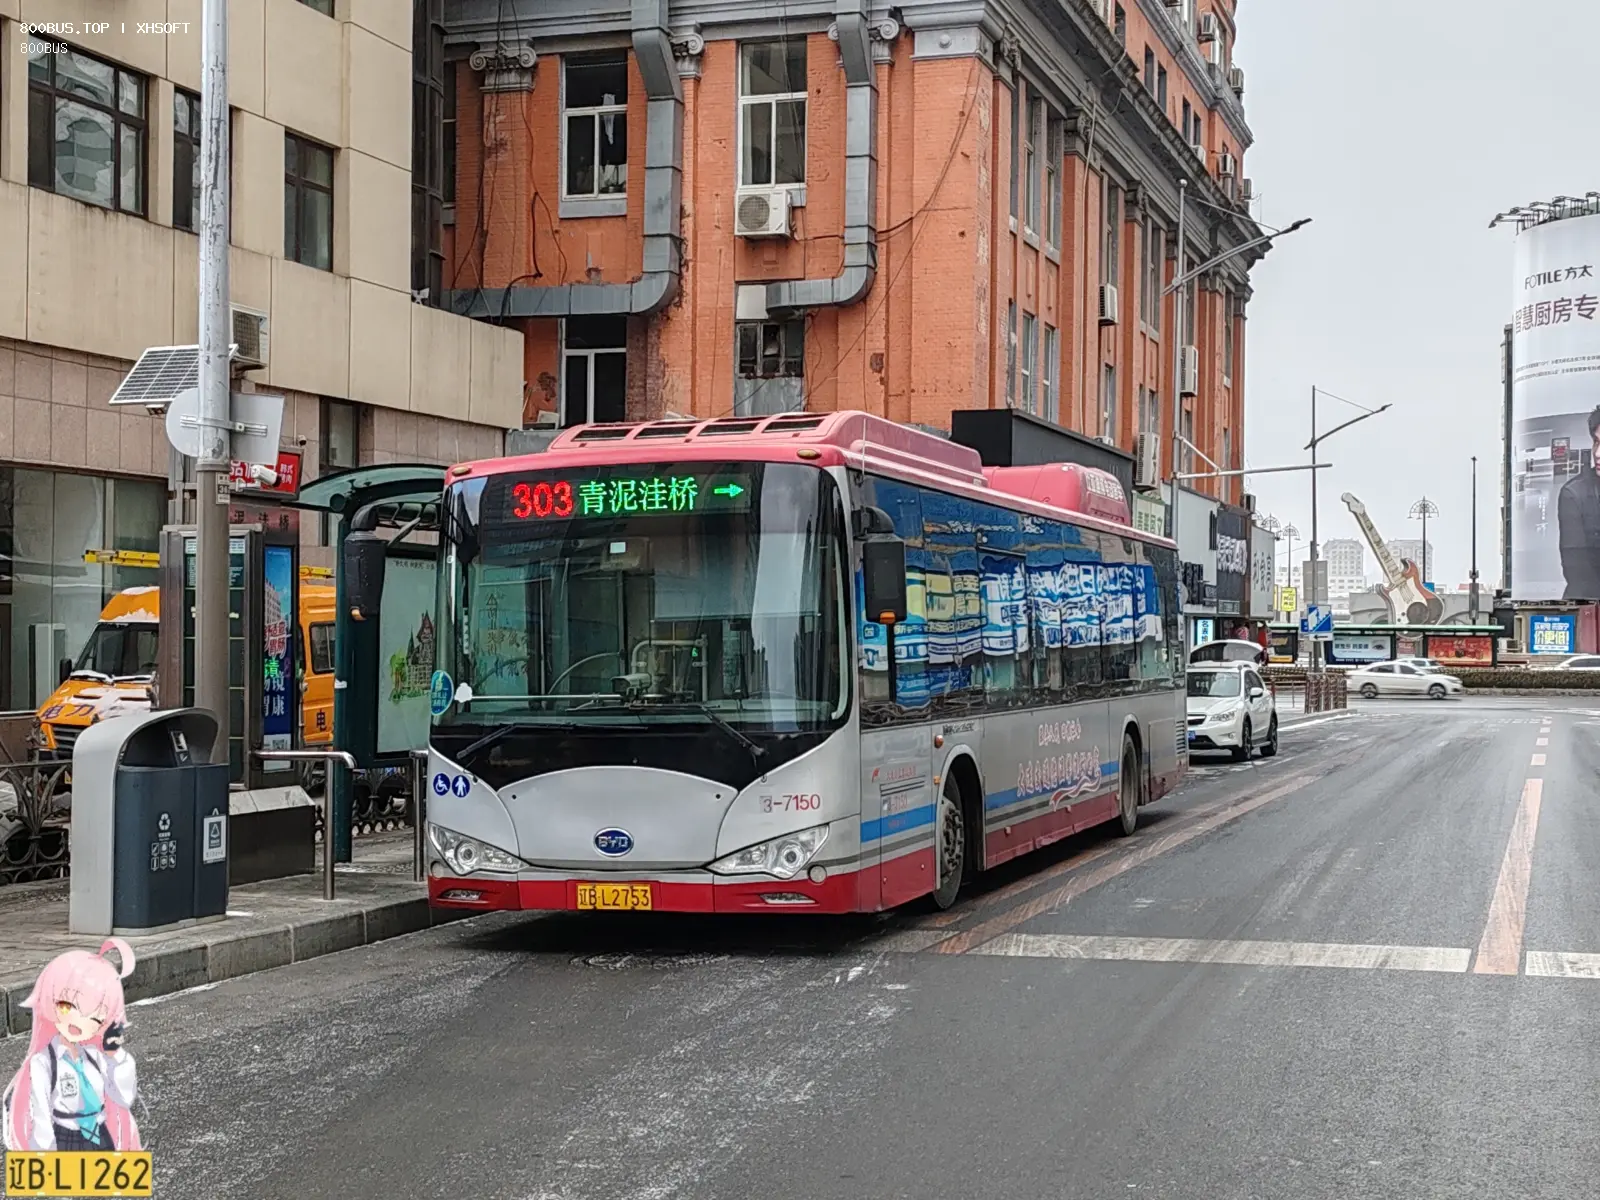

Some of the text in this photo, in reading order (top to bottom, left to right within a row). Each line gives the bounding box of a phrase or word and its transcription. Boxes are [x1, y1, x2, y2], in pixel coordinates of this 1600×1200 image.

[1525, 265, 1593, 289] FOTILE 方太
[513, 476, 698, 518] 303 青泥洼桥
[597, 835, 629, 848] BYD
